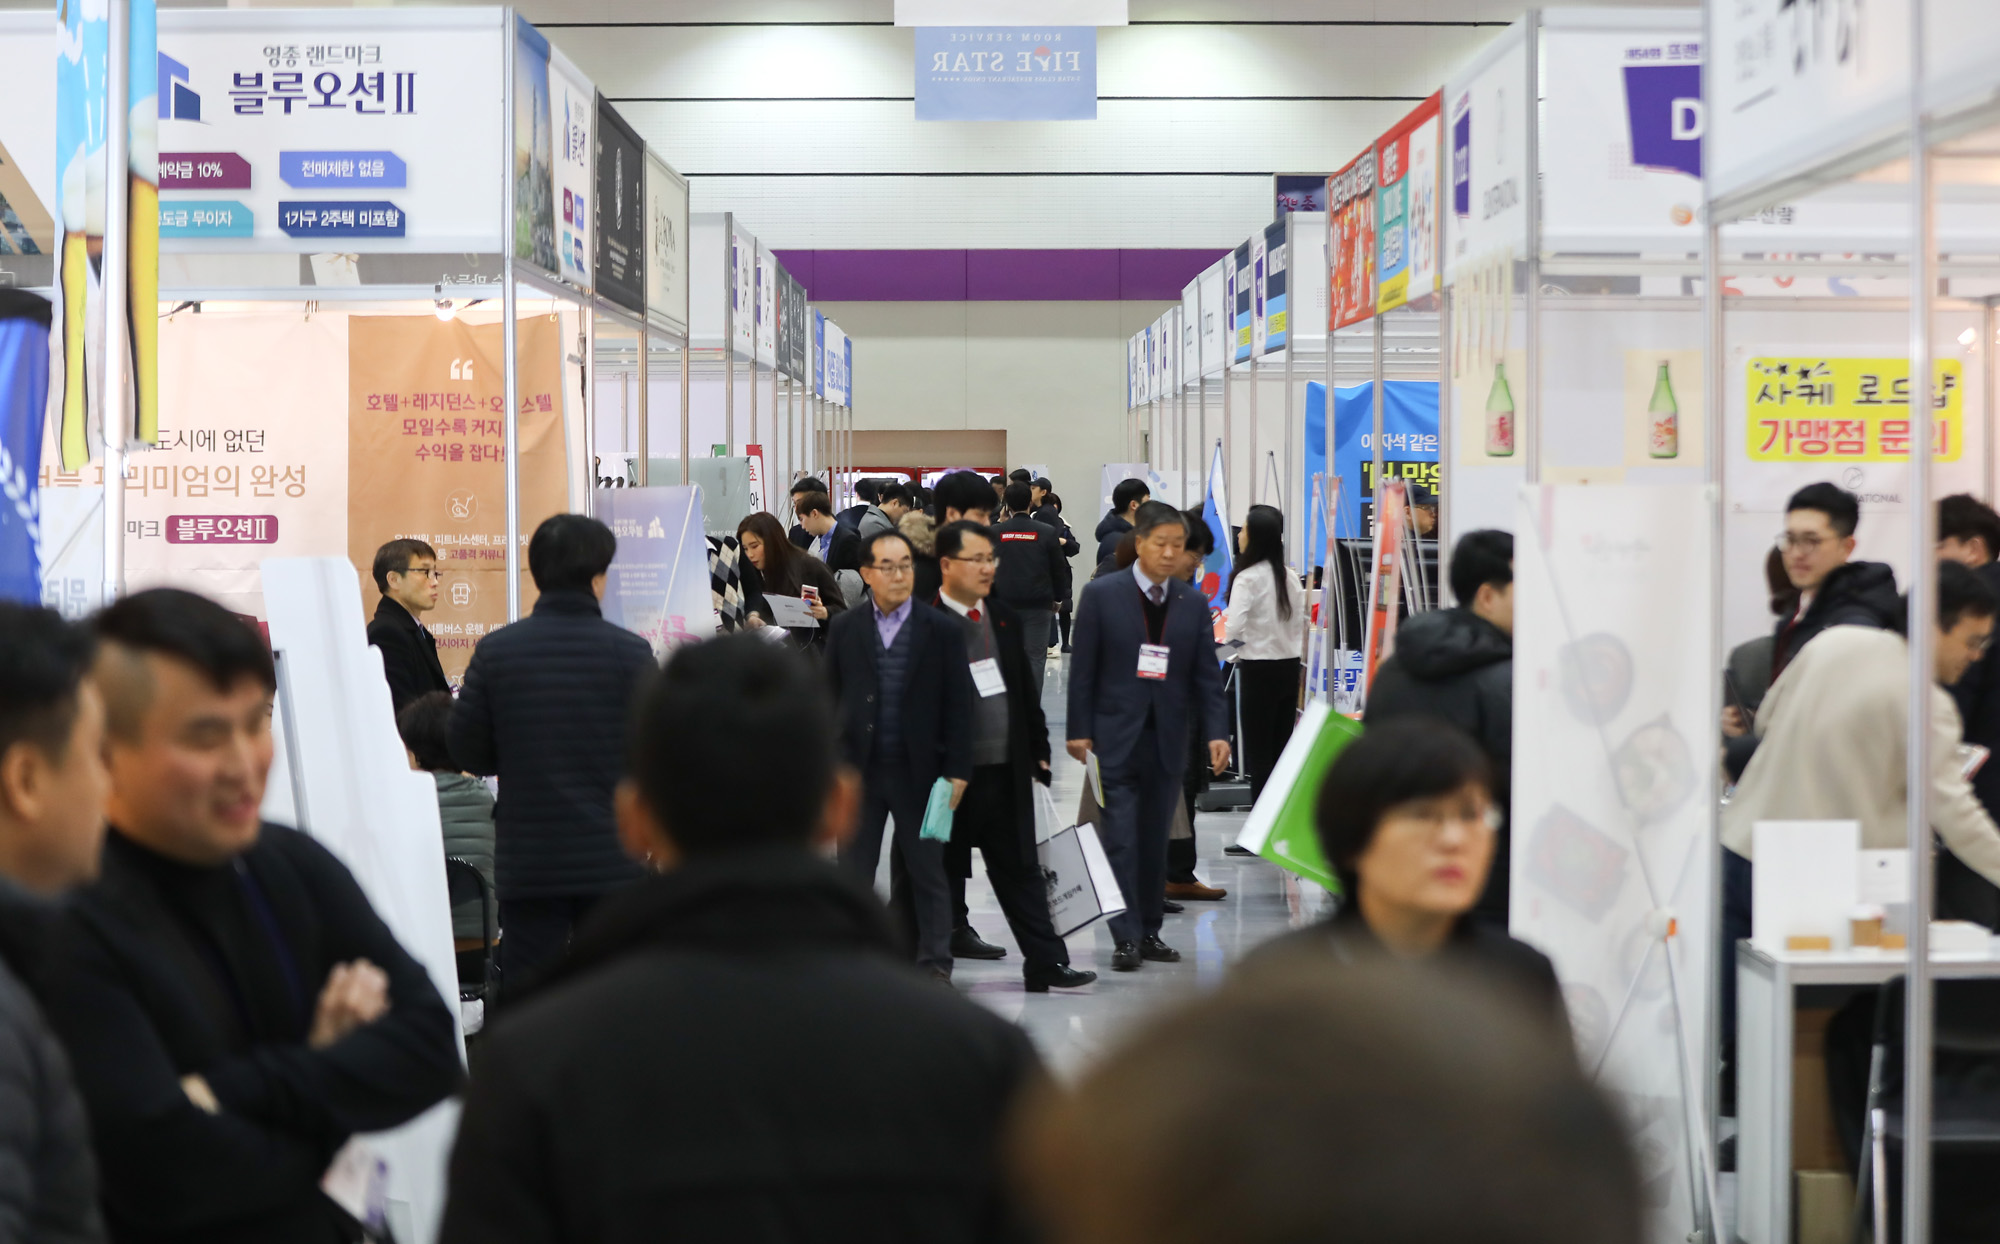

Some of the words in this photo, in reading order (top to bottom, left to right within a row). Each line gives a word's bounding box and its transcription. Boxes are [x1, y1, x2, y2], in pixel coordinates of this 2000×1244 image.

[263, 45, 301, 68] 영종
[306, 45, 383, 67] 랜드마크
[197, 162, 223, 178] 10%
[301, 158, 354, 178] 전매제한
[358, 158, 385, 178] 없음
[192, 209, 233, 227] 무이자
[285, 209, 317, 228] 1가구
[320, 209, 355, 228] 2주택
[359, 208, 399, 228] 미포함
[366, 393, 553, 414] 호텔+레지던스+오스텔
[402, 418, 468, 437] 모일수록
[1759, 419, 1866, 455] 가맹점
[223, 429, 265, 453] 없던
[415, 443, 465, 462] 수익을
[249, 464, 307, 498] 완성
[434, 534, 490, 546] 피트니스센터,
